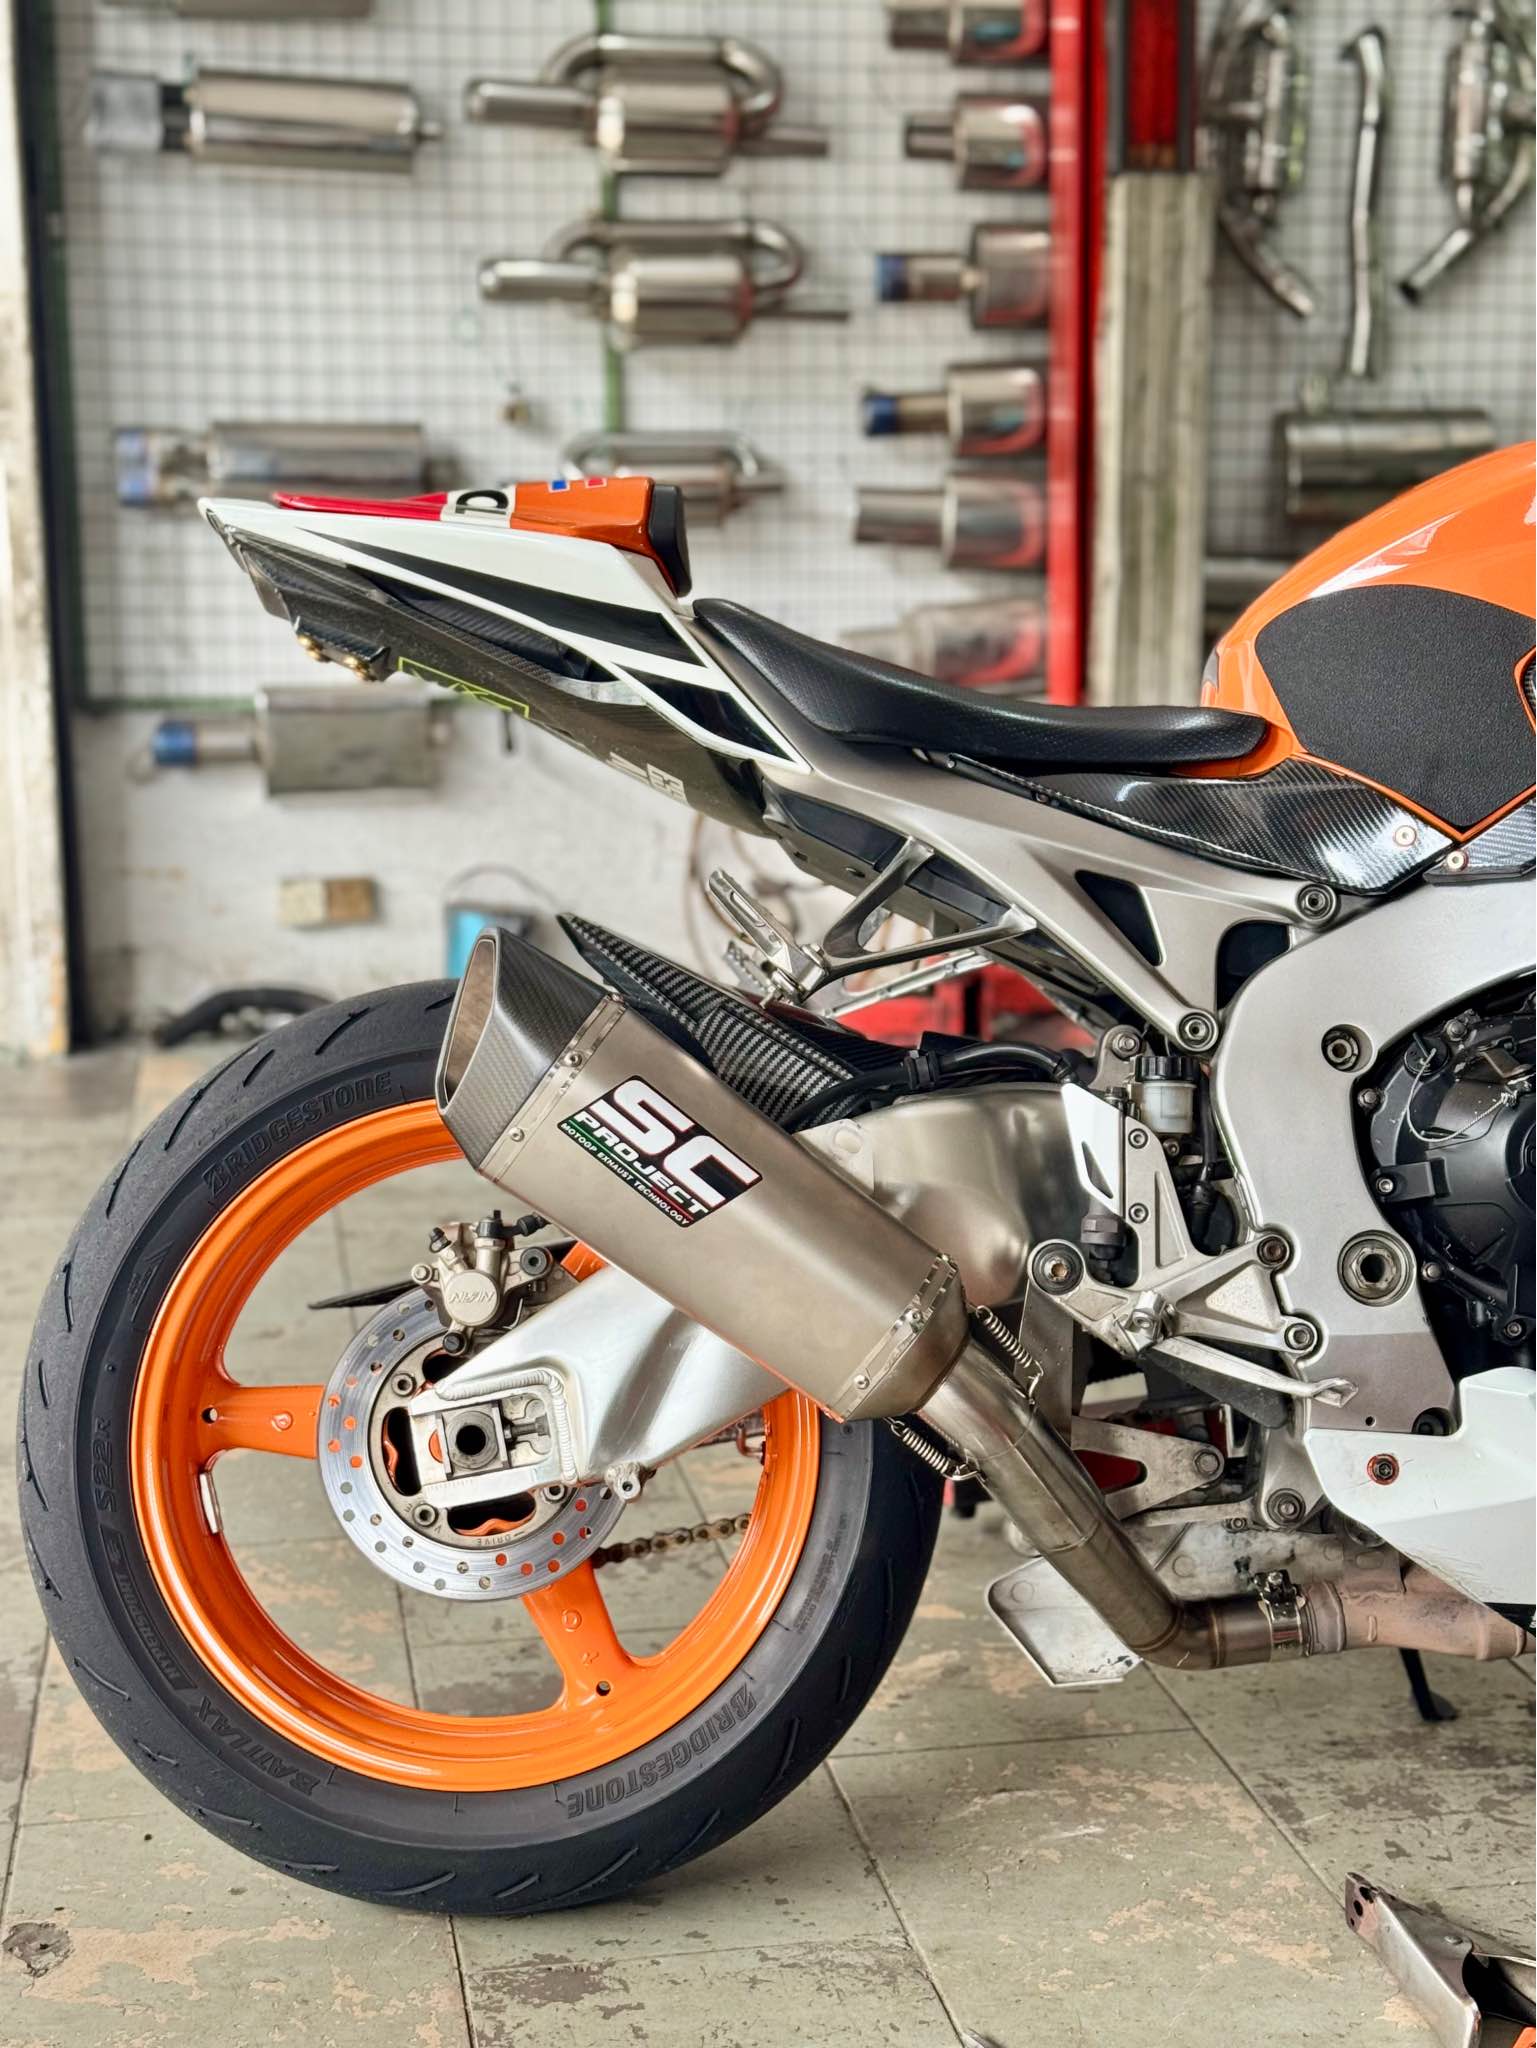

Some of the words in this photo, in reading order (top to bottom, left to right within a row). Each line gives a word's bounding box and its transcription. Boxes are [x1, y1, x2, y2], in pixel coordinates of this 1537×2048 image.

[202, 1071, 392, 1198] BRIDGESTONE
[560, 1122, 598, 1152] MOTOGP
[599, 1152, 634, 1182] EXHAUST
[633, 1180, 691, 1225] TECHNOLOGY
[573, 1111, 709, 1214] PROJECT
[588, 1079, 760, 1208] SC
[197, 1696, 321, 1797] BATTLAX
[567, 1682, 757, 1819] BRIDGESTONE
